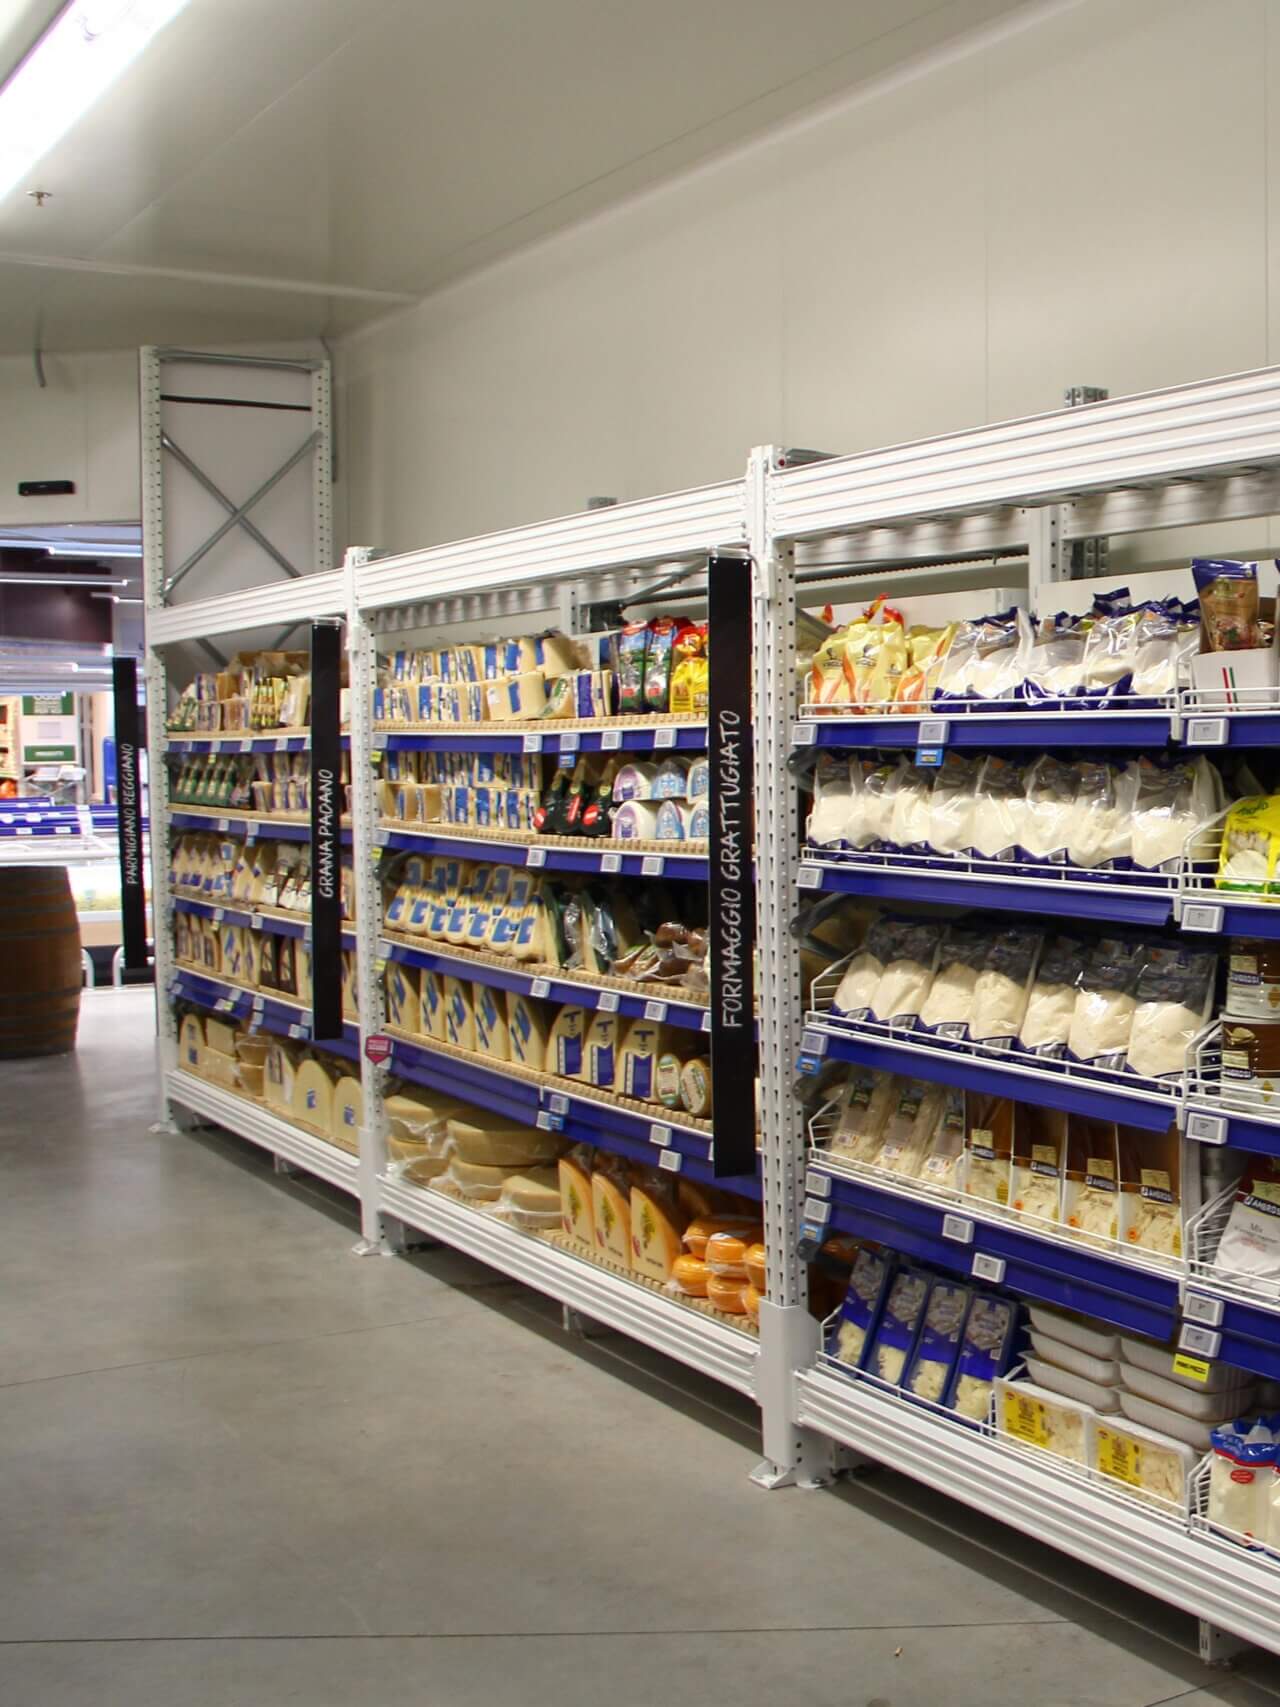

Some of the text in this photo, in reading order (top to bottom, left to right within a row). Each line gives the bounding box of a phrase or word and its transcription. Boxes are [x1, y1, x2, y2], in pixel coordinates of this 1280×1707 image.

[120, 743, 139, 885] PARMIGIANO REGGIANO
[317, 768, 334, 898] GRANA PADANO
[719, 709, 743, 1028] FORMAGGIO GRATTUGIATO
